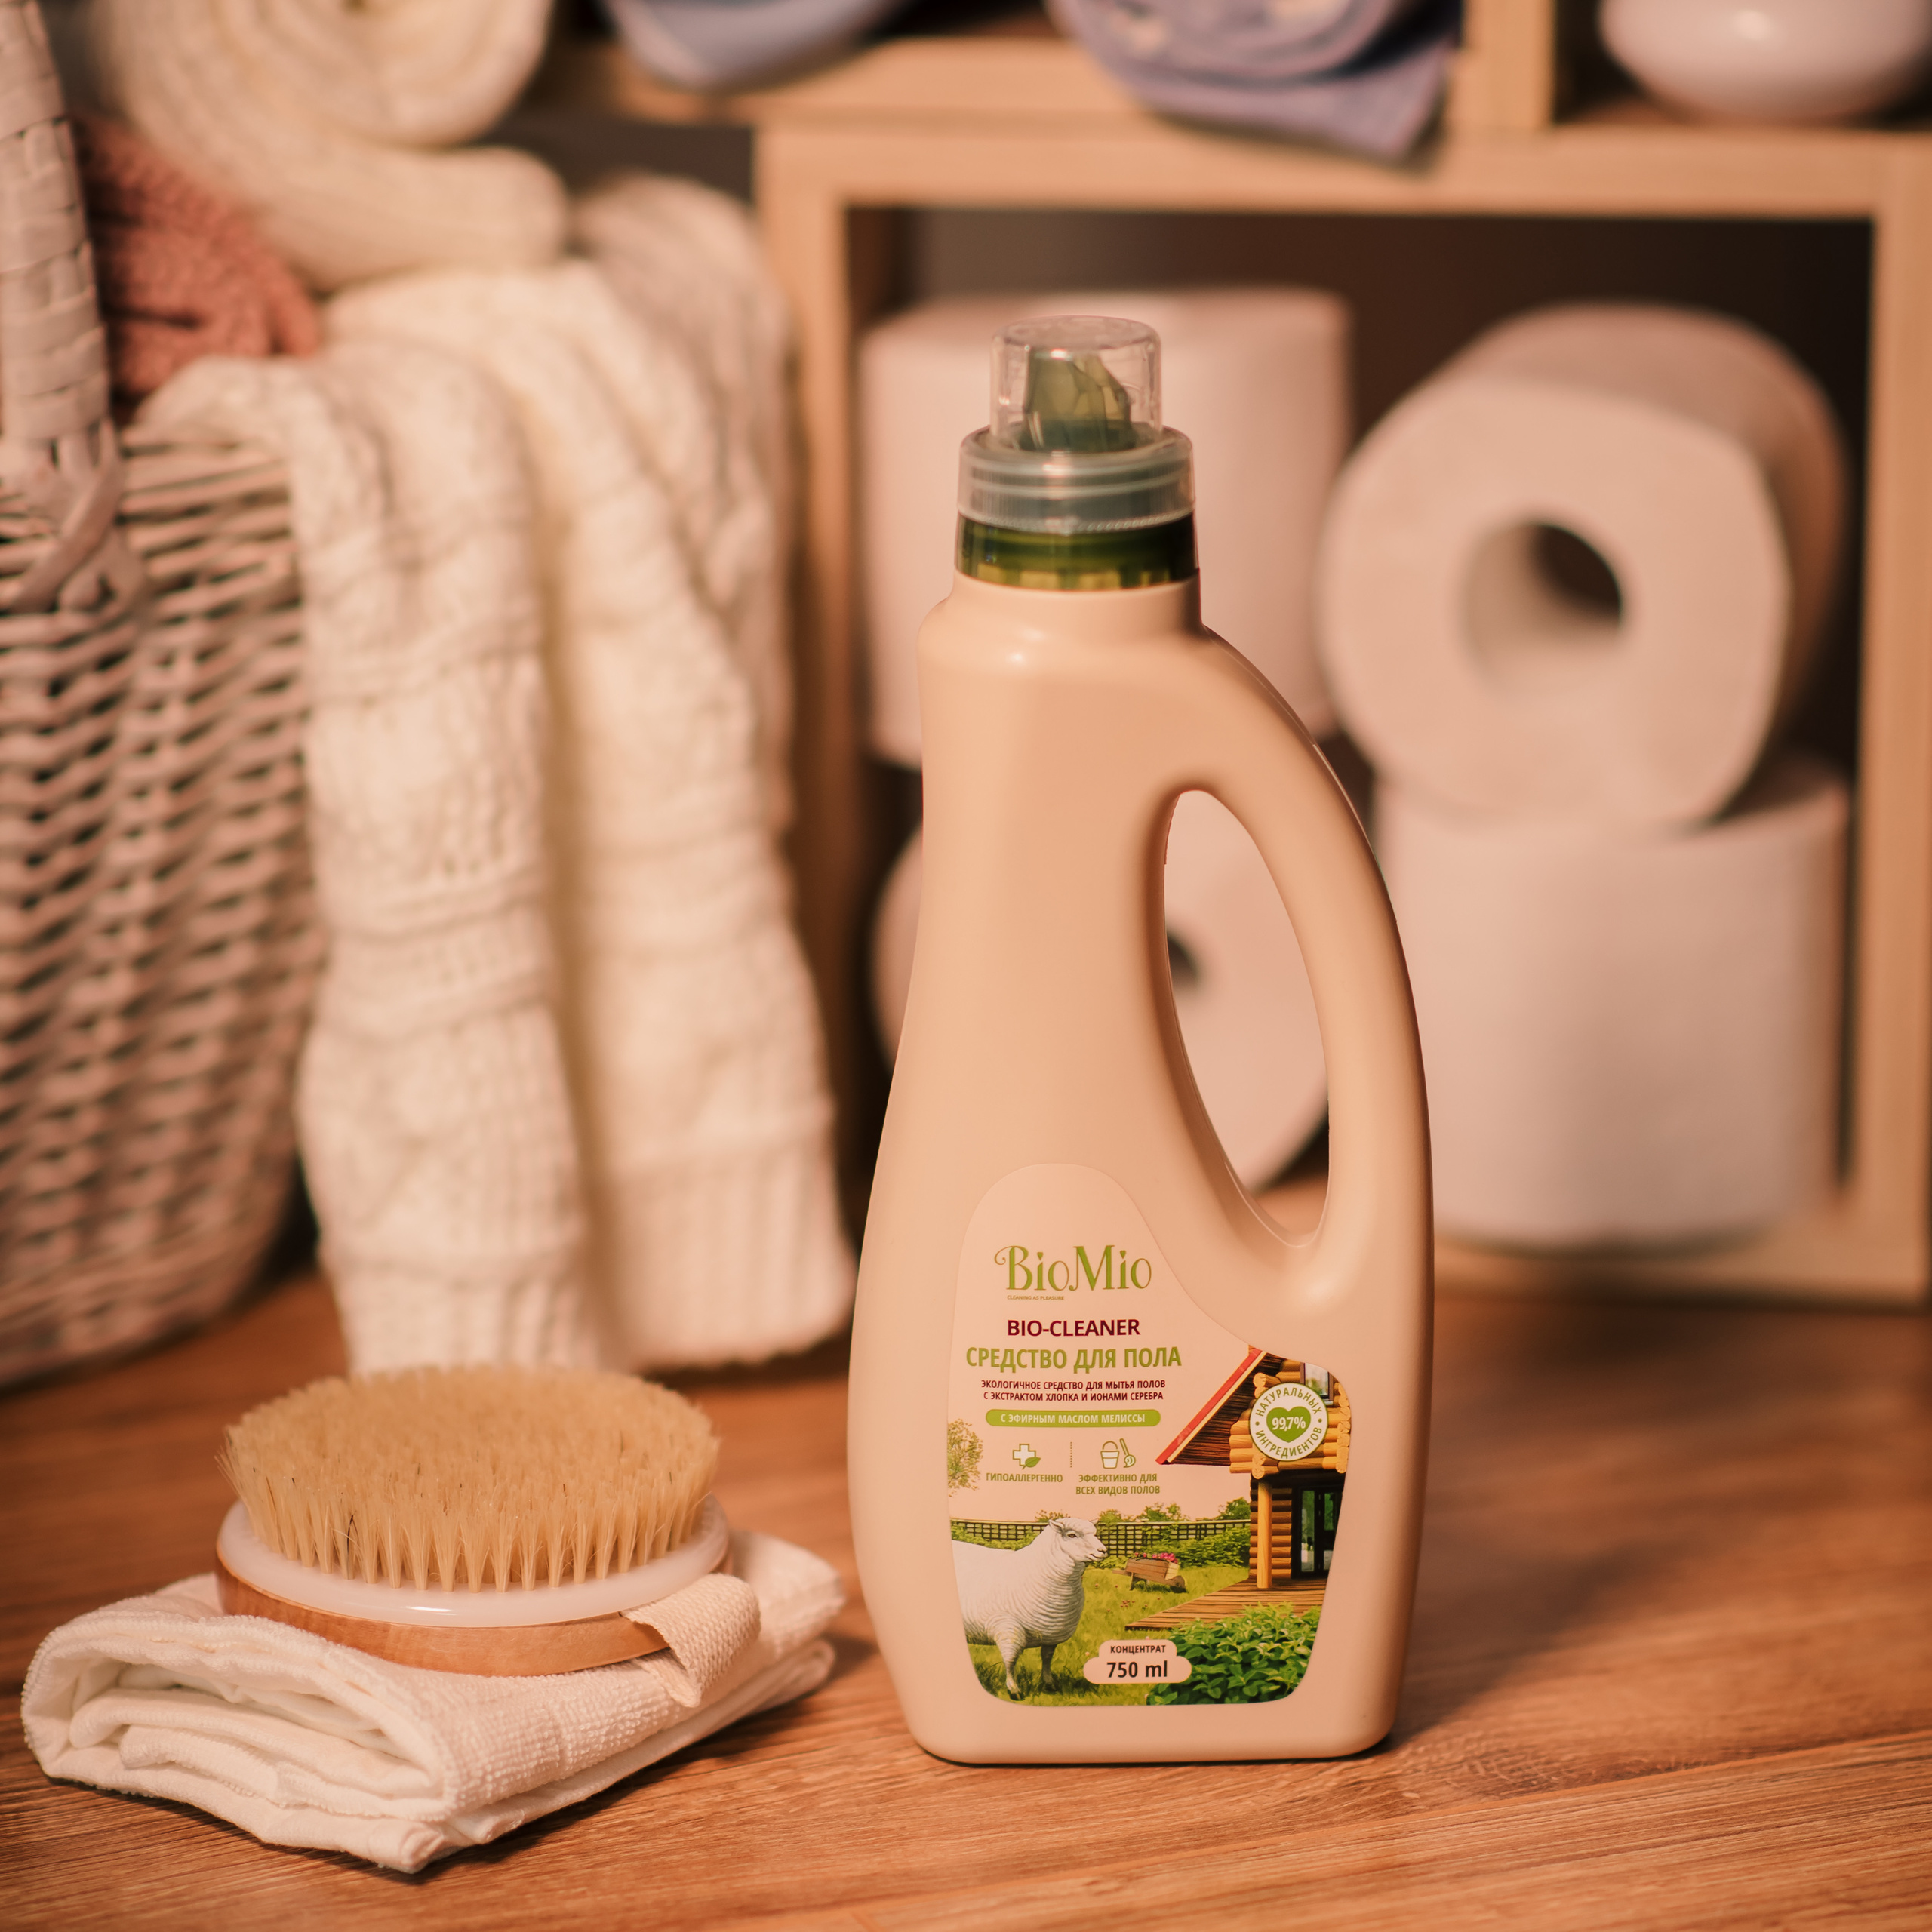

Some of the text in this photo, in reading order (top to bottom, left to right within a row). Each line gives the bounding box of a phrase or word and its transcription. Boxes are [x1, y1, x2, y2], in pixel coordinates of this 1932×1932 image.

[994, 1244, 1152, 1291] BioMio
[1008, 1319, 1140, 1337] BIO-CLEANER
[966, 1346, 1182, 1374] СРЕДСТВО ДЛЯ ПОЛА
[981, 1380, 1166, 1391] ЭКОЛОГИЧНОЕ СРЕДСТВО ДЛЯ МЫТЬЯ ПОЛОВ
[983, 1392, 1164, 1401] С ЭКСТРАКТОМ ХЛОПКА И ИОНАМИ СЕРЕБРА
[1255, 1387, 1322, 1417] НАТУРАЛЬНЫХ
[1001, 1414, 1146, 1423] С ЭФИРНЫМ МАСЛОМ МЕЛИССЫ
[1272, 1416, 1306, 1432] 99,7%
[1255, 1427, 1322, 1459] ИНГРЕДИЕНТОВ
[986, 1472, 1063, 1483] ГИПОАЛЛЕРГЕННО
[1078, 1473, 1158, 1484] ЭФФЕКТИВНО ДЛЯ
[1075, 1485, 1161, 1496] ВСЕХ ВИДОВ ПОЛОВ
[1110, 1645, 1166, 1655] КОНЦЕНТРАТ
[1106, 1660, 1168, 1678] 750 ml
